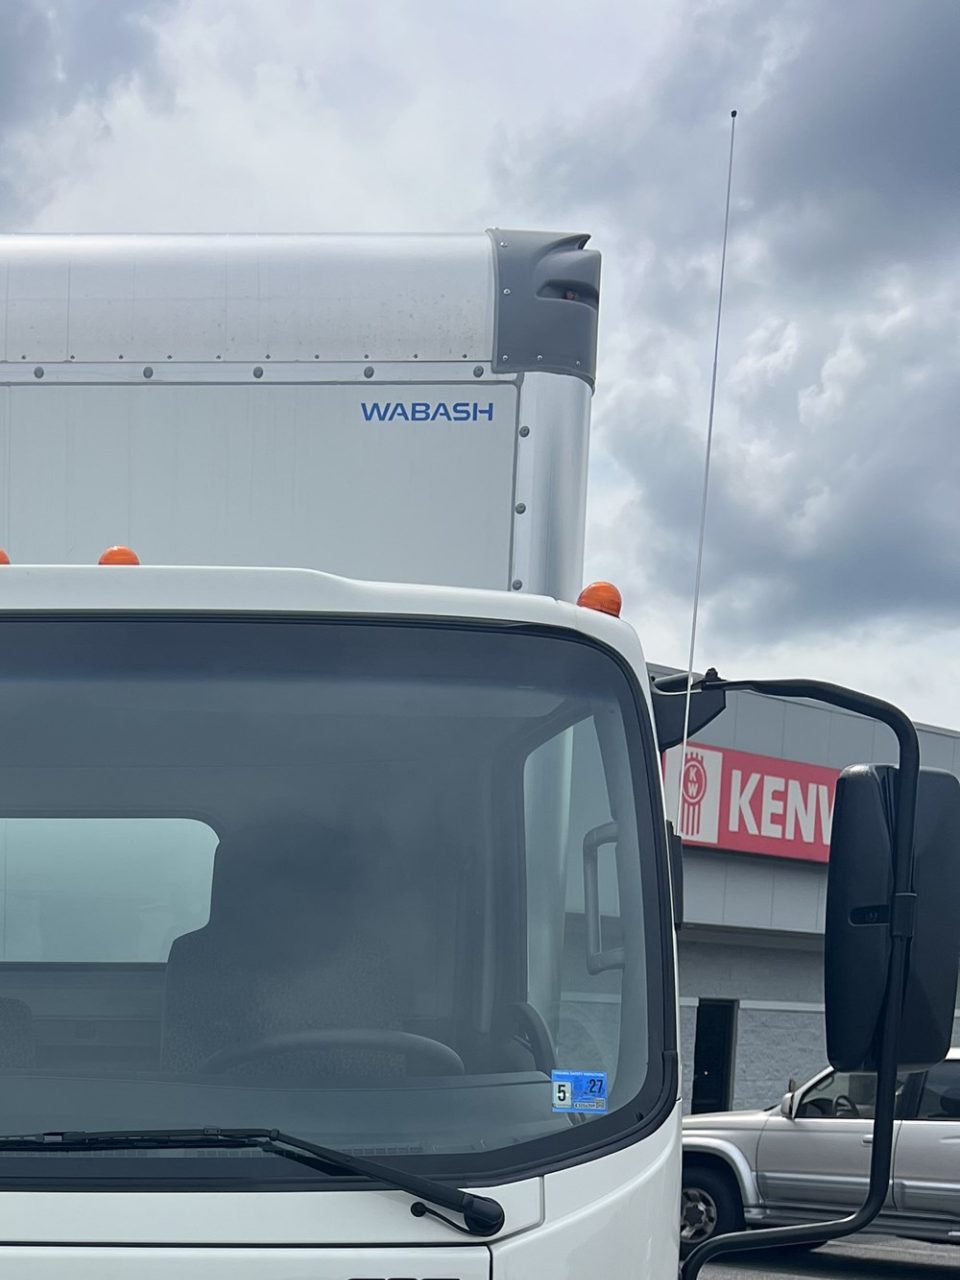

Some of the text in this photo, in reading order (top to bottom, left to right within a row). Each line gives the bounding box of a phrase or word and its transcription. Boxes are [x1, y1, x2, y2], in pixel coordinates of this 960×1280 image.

[360, 402, 494, 422] WABASH
[557, 1084, 566, 1102] 5
[589, 1078, 604, 1094] 27
